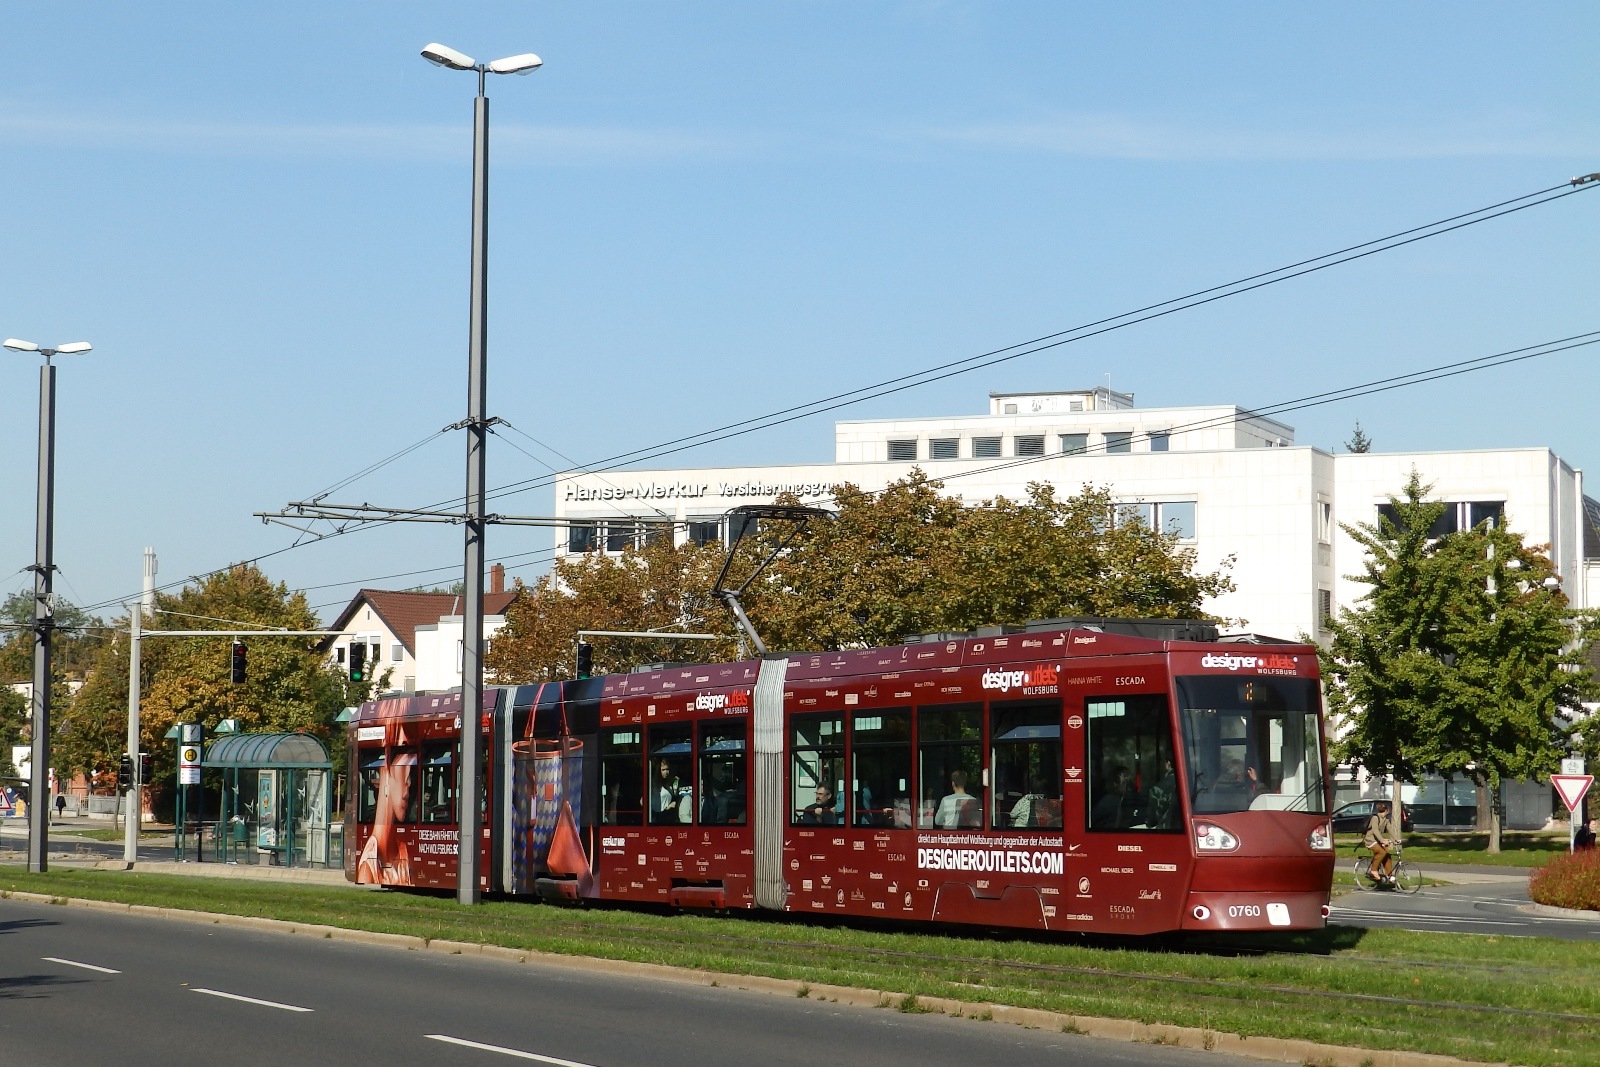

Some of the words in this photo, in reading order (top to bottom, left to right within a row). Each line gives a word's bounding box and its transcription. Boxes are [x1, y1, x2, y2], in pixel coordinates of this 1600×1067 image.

[564, 481, 708, 502] Hanse-Merkur
[1257, 668, 1297, 676] WOLFSBURG
[1086, 676, 1102, 684] WHITE
[1115, 676, 1146, 686] ESCADA
[1023, 685, 1058, 695] WOLFSBURG
[1029, 836, 1038, 846] der
[887, 853, 906, 861] ESCADA
[917, 848, 1064, 875] DESIGNEROUTLETS.COM
[1109, 905, 1135, 913] ESCADA
[1228, 905, 1261, 918] 0760
